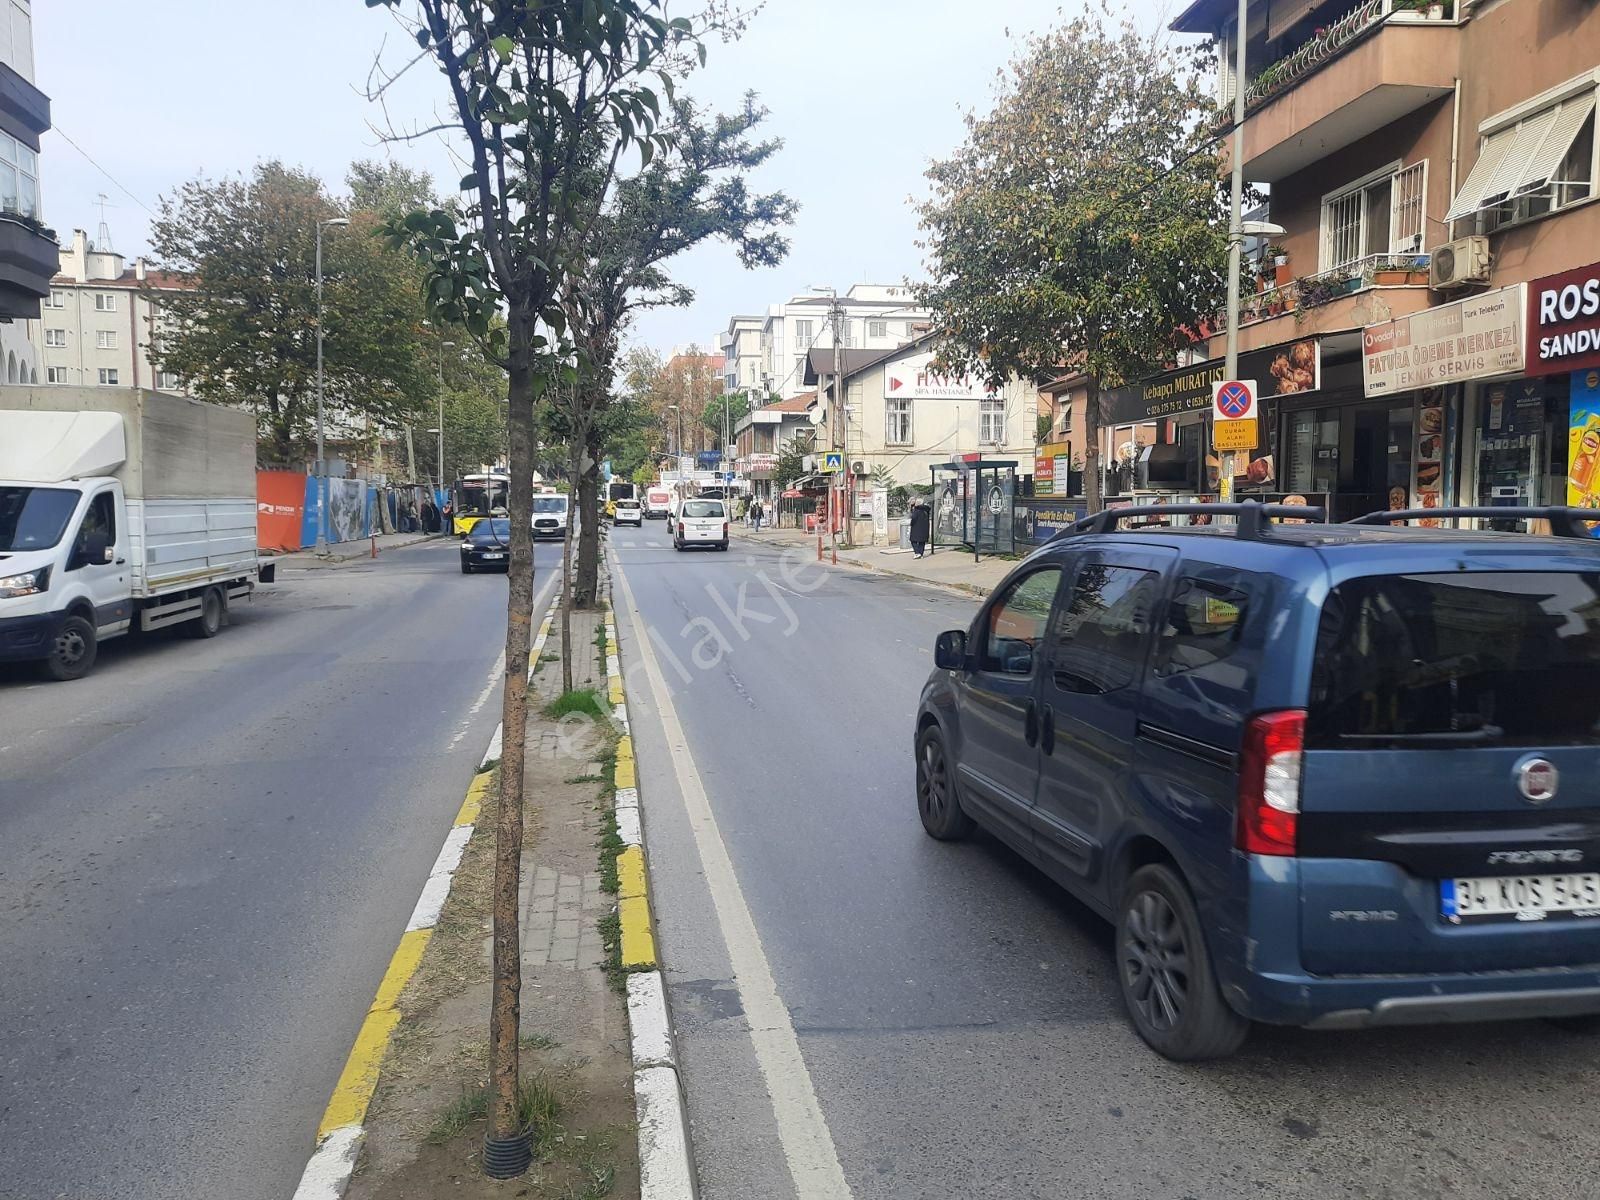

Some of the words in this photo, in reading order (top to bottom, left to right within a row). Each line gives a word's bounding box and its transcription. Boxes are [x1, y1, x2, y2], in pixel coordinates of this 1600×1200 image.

[1479, 303, 1505, 316] Telekom
[1369, 350, 1410, 375] FATURA
[1413, 342, 1454, 365] ÖDEME
[1457, 321, 1518, 355] MERKEZİ
[1439, 356, 1485, 377] SERVİS
[1143, 383, 1173, 400] Kebapçı
[1174, 371, 1207, 394] MURAT
[1208, 366, 1226, 386] UST
